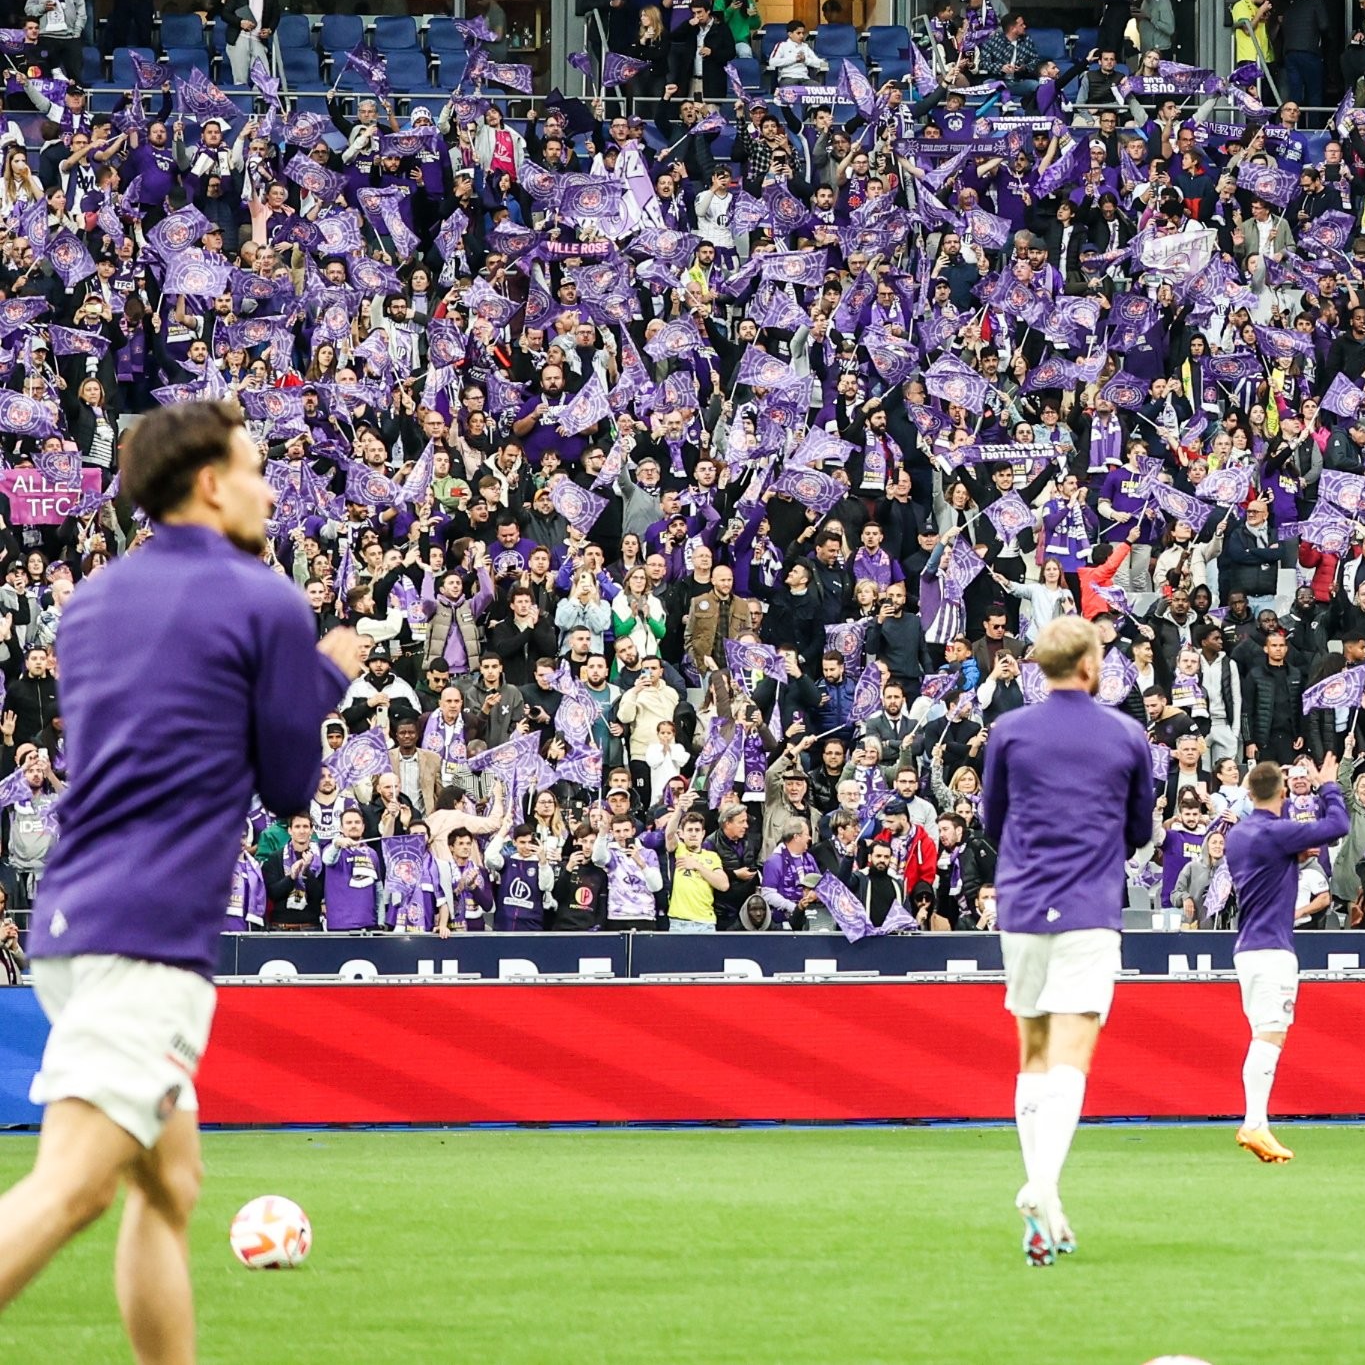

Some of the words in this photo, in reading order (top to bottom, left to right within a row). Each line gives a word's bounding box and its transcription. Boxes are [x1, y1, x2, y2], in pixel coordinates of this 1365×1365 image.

[801, 95, 836, 105] FOOTBALL
[1032, 122, 1053, 132] CLUB
[546, 241, 580, 255] VILLE
[580, 241, 610, 255] ROSE
[116, 280, 132, 289] TFC
[980, 449, 1029, 460] FOOTBALL
[1029, 448, 1055, 458] CLUB
[11, 474, 83, 494] ALLE
[26, 497, 72, 518] TFC
